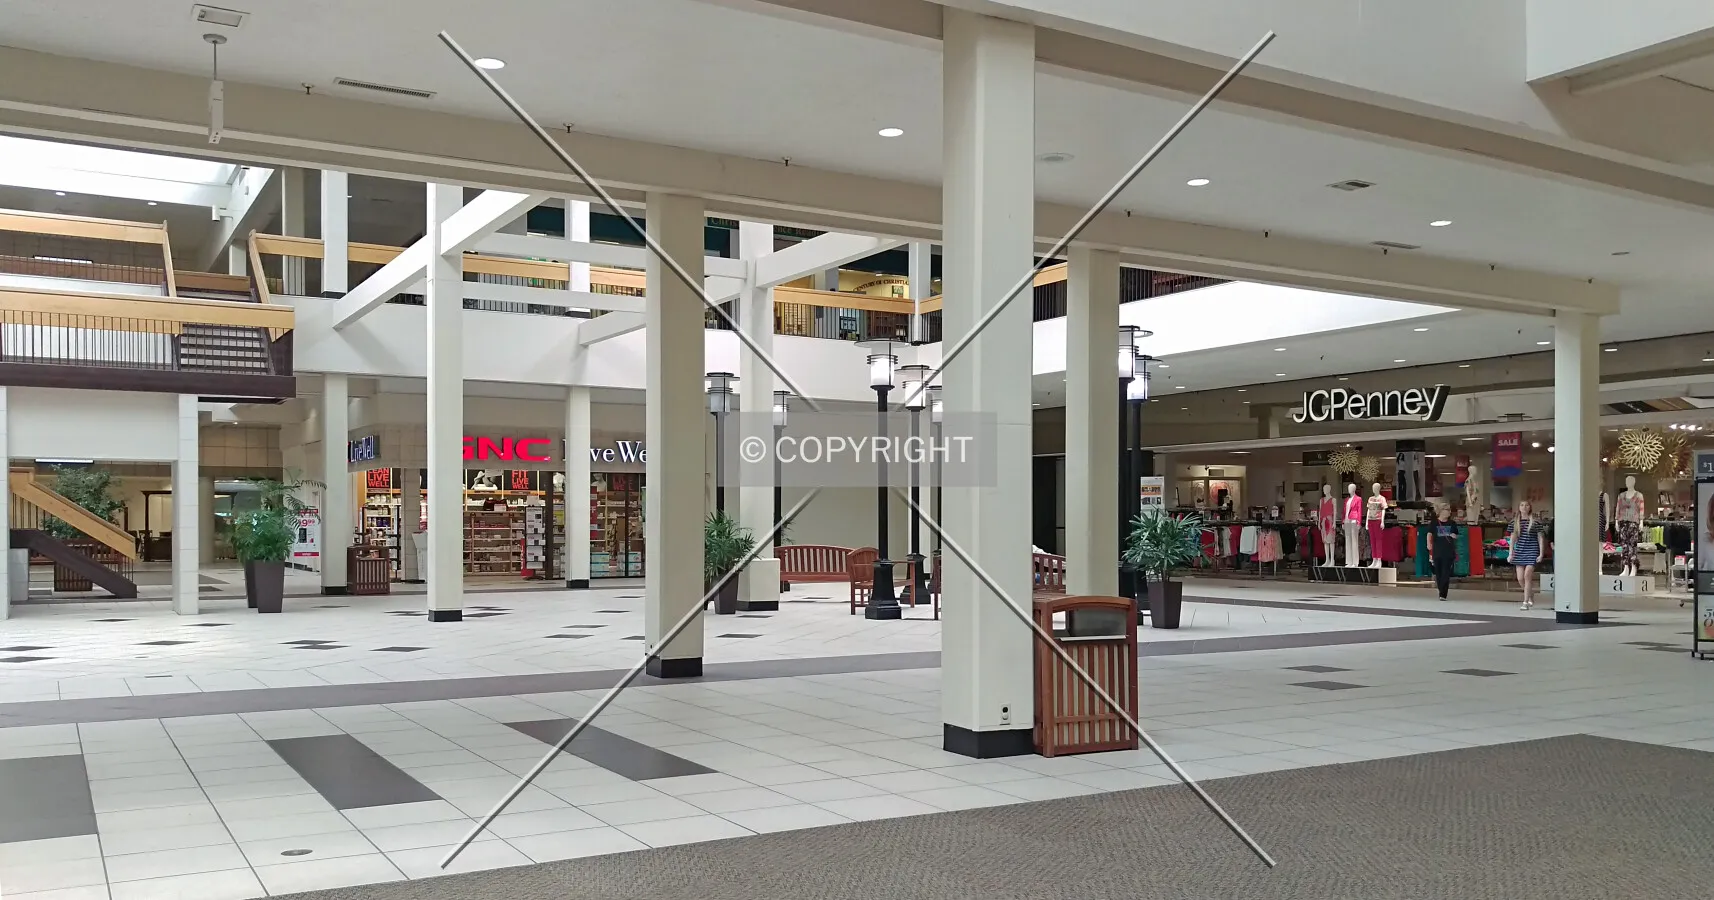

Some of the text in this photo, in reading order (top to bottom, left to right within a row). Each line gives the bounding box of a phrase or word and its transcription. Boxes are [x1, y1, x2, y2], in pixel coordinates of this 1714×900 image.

[1292, 384, 1444, 423] JCPenney
[512, 470, 529, 478] FIT
[1613, 579, 1624, 591] a
[1641, 580, 1648, 591] a
